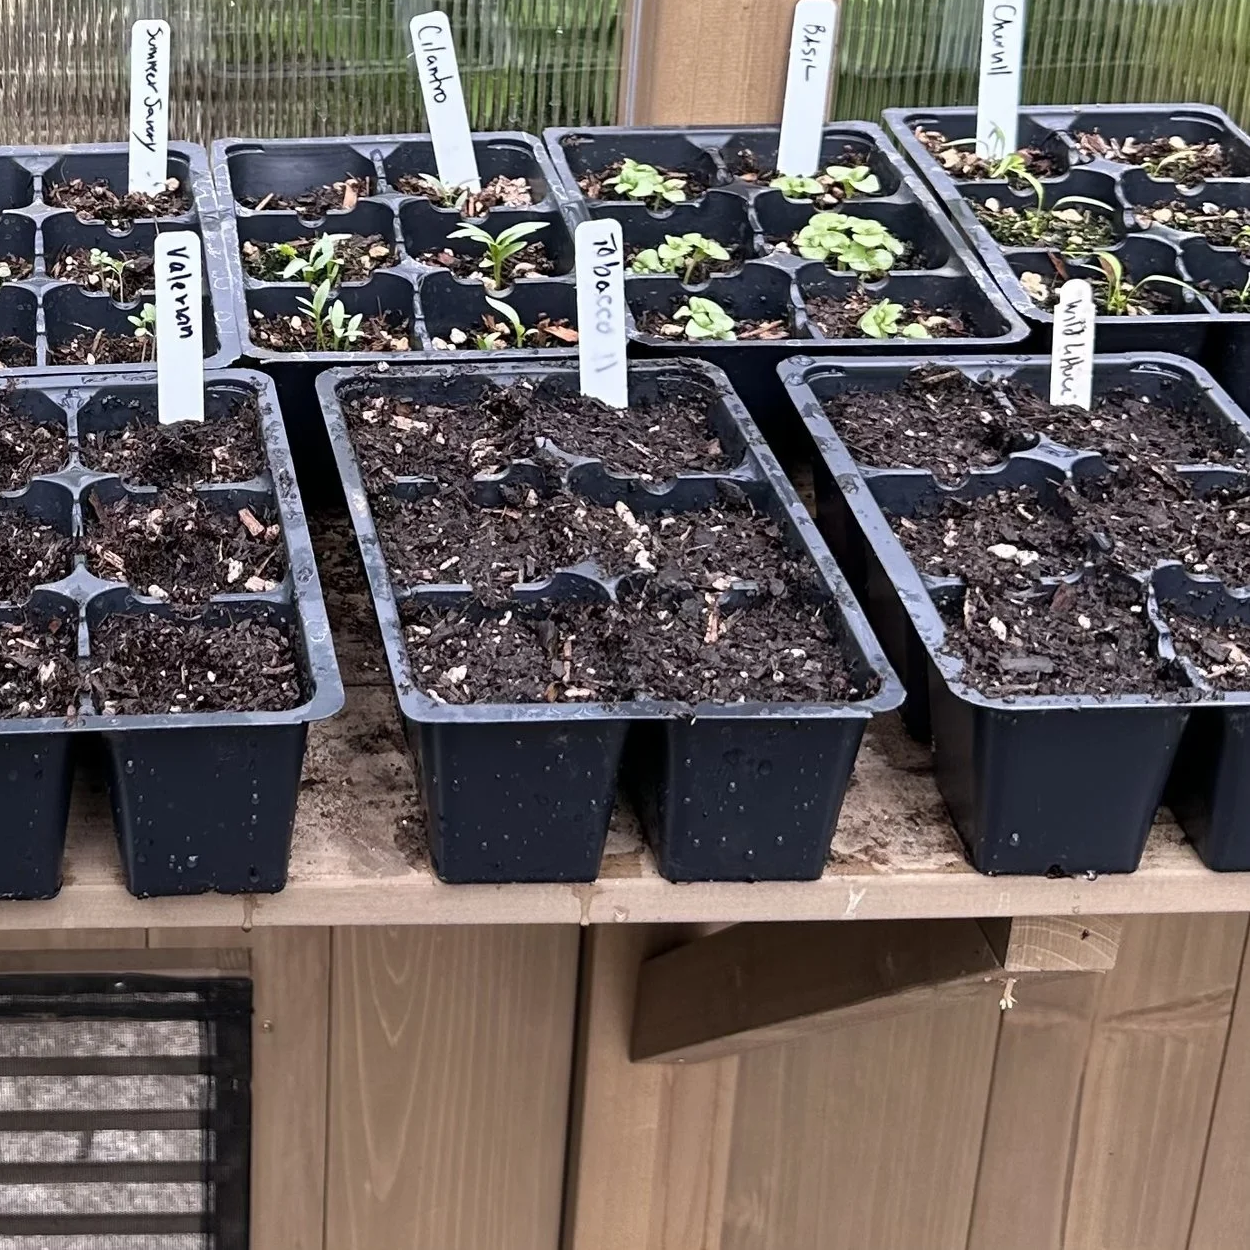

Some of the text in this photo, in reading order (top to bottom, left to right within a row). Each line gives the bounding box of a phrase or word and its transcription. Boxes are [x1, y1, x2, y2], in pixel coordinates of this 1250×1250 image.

[418, 25, 454, 103] Cilantro
[166, 246, 193, 339] Valerian
[593, 232, 620, 335] Tobacco
[1062, 299, 1086, 336] Wild
